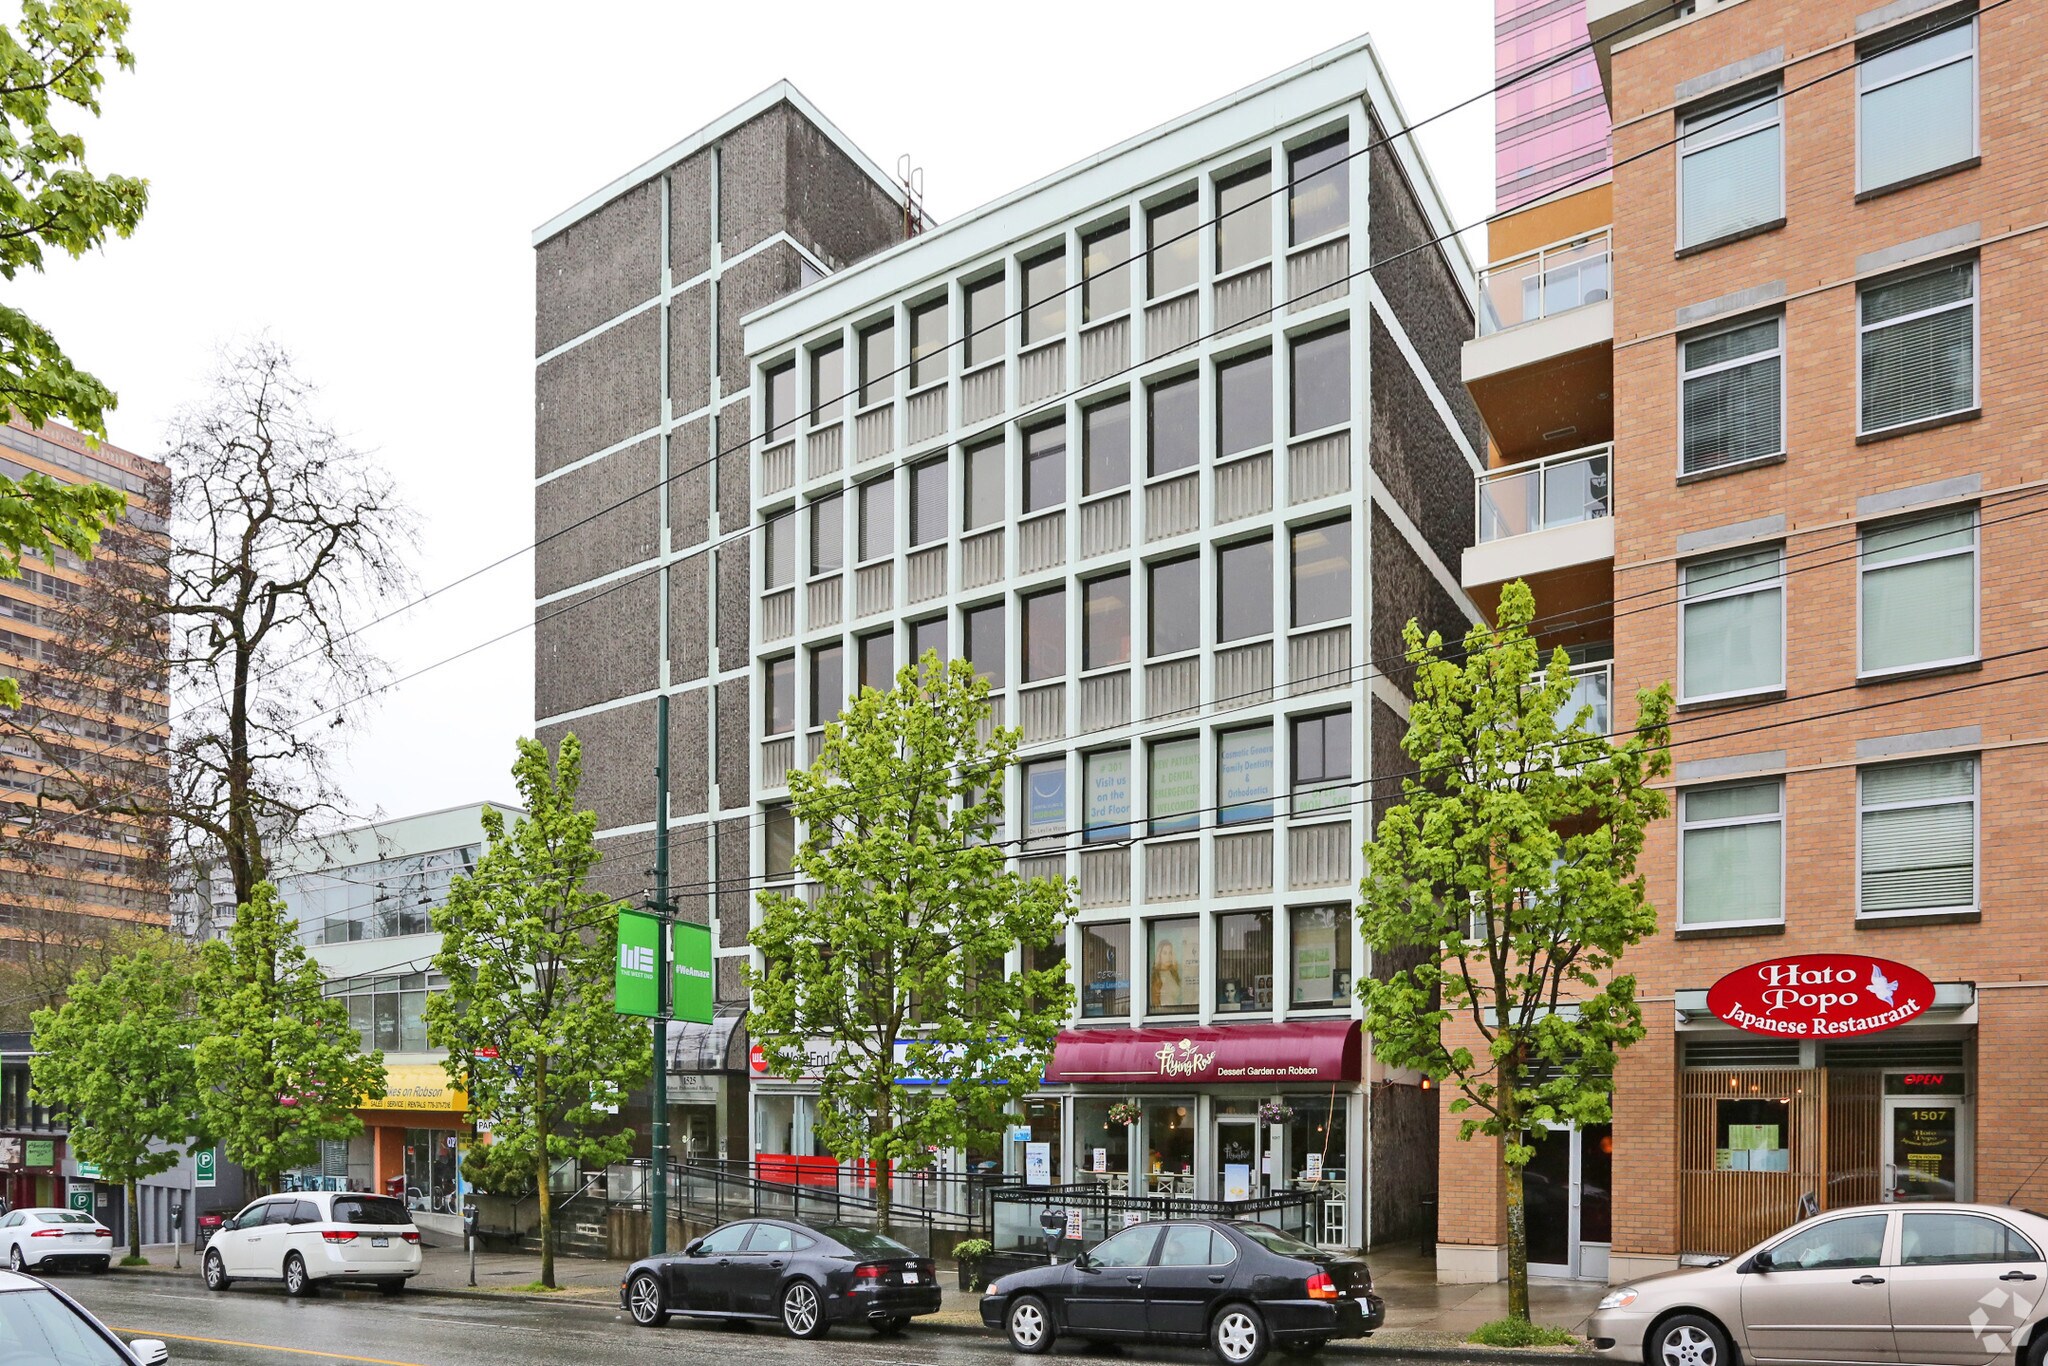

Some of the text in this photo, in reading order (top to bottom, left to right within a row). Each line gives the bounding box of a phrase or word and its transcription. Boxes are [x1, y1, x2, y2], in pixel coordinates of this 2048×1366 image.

[1095, 776, 1126, 788] Visit us
[1168, 770, 1193, 782] DENTAL
[1097, 790, 1124, 802] on the
[1227, 786, 1269, 799] Orthodontics
[1090, 805, 1130, 817] 3rd Floor
[621, 969, 631, 977] THE
[631, 971, 644, 979] WEST
[675, 964, 710, 979] #WeAmaze
[1758, 964, 1857, 987] Hato
[1761, 988, 1859, 1016] Popo
[1722, 997, 1921, 1035] Japanese Restaurant
[810, 1051, 830, 1066] End
[1155, 1050, 1216, 1077] Flying Rose
[1217, 1066, 1318, 1076] Dessert Garden on Robson
[683, 1077, 697, 1085] 1525
[1903, 1073, 1944, 1085] OPEN
[402, 1088, 413, 1097] on
[413, 1085, 443, 1098] Robson
[370, 1100, 383, 1108] SALES
[386, 1100, 404, 1108] SERVICE
[407, 1101, 426, 1109] RENTALS
[1911, 1111, 1946, 1121] 1507
